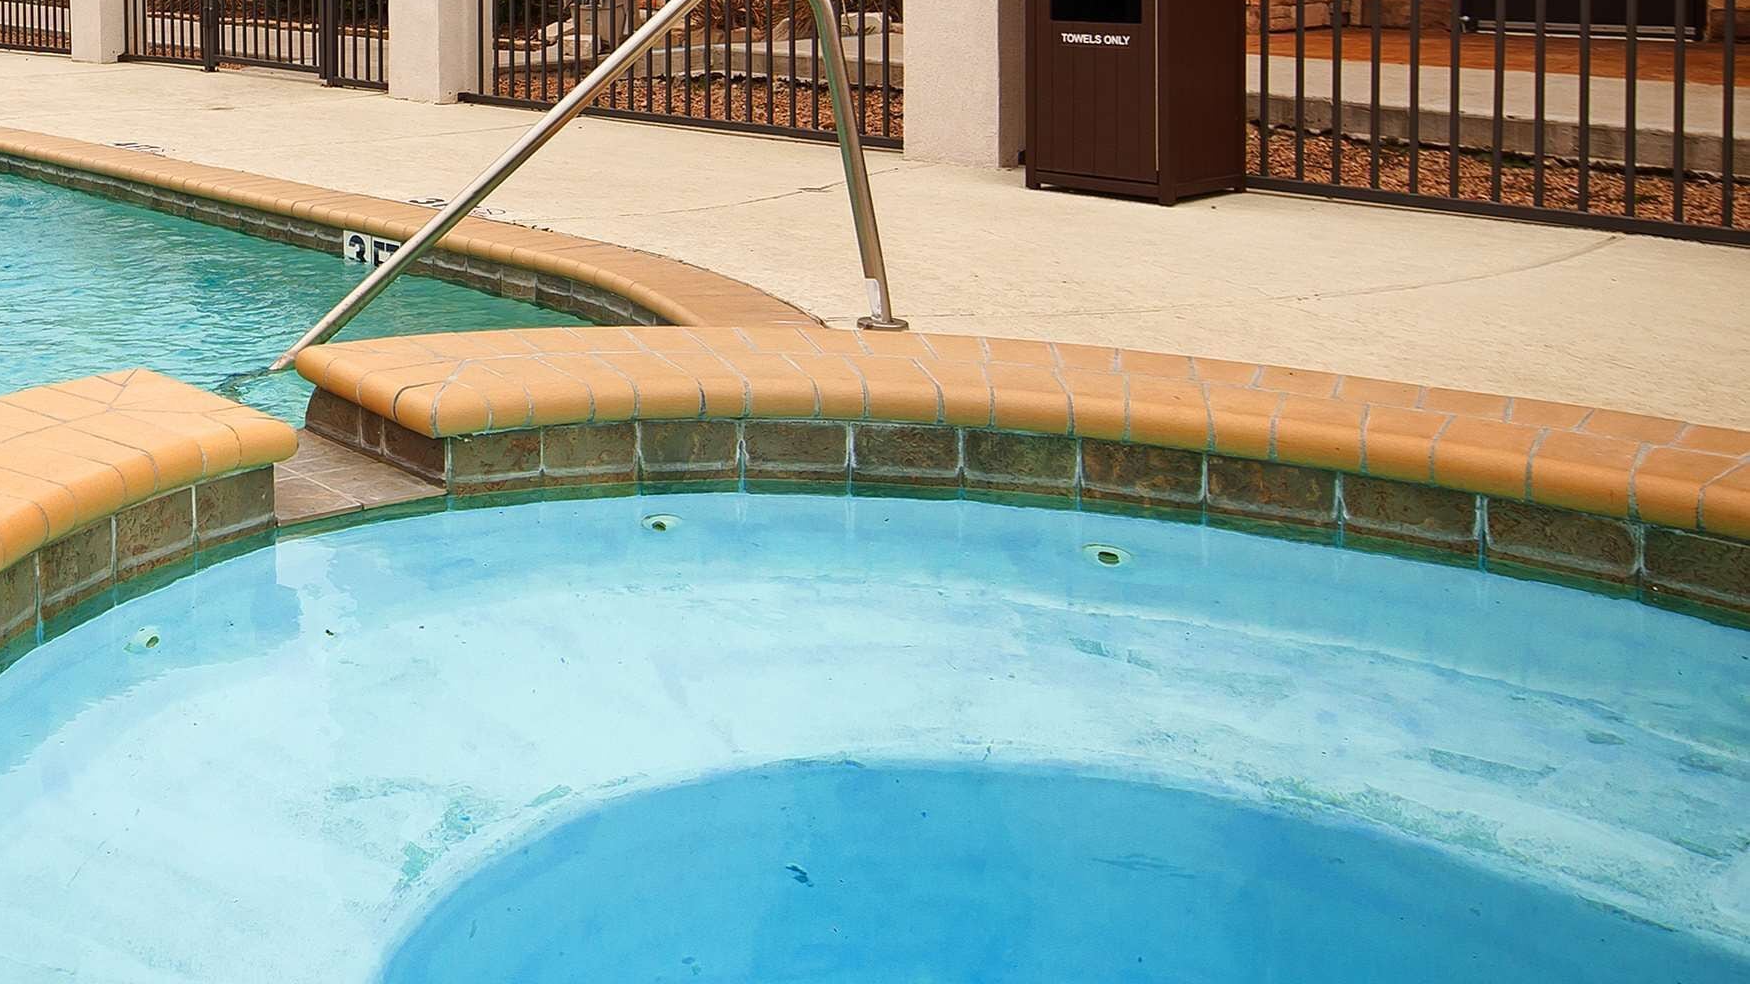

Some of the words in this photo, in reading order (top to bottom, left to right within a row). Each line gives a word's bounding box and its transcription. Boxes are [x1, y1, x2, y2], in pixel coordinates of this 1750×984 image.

[1061, 32, 1102, 45] TOWELS
[1103, 34, 1131, 46] ONLY
[349, 234, 367, 263] 3
